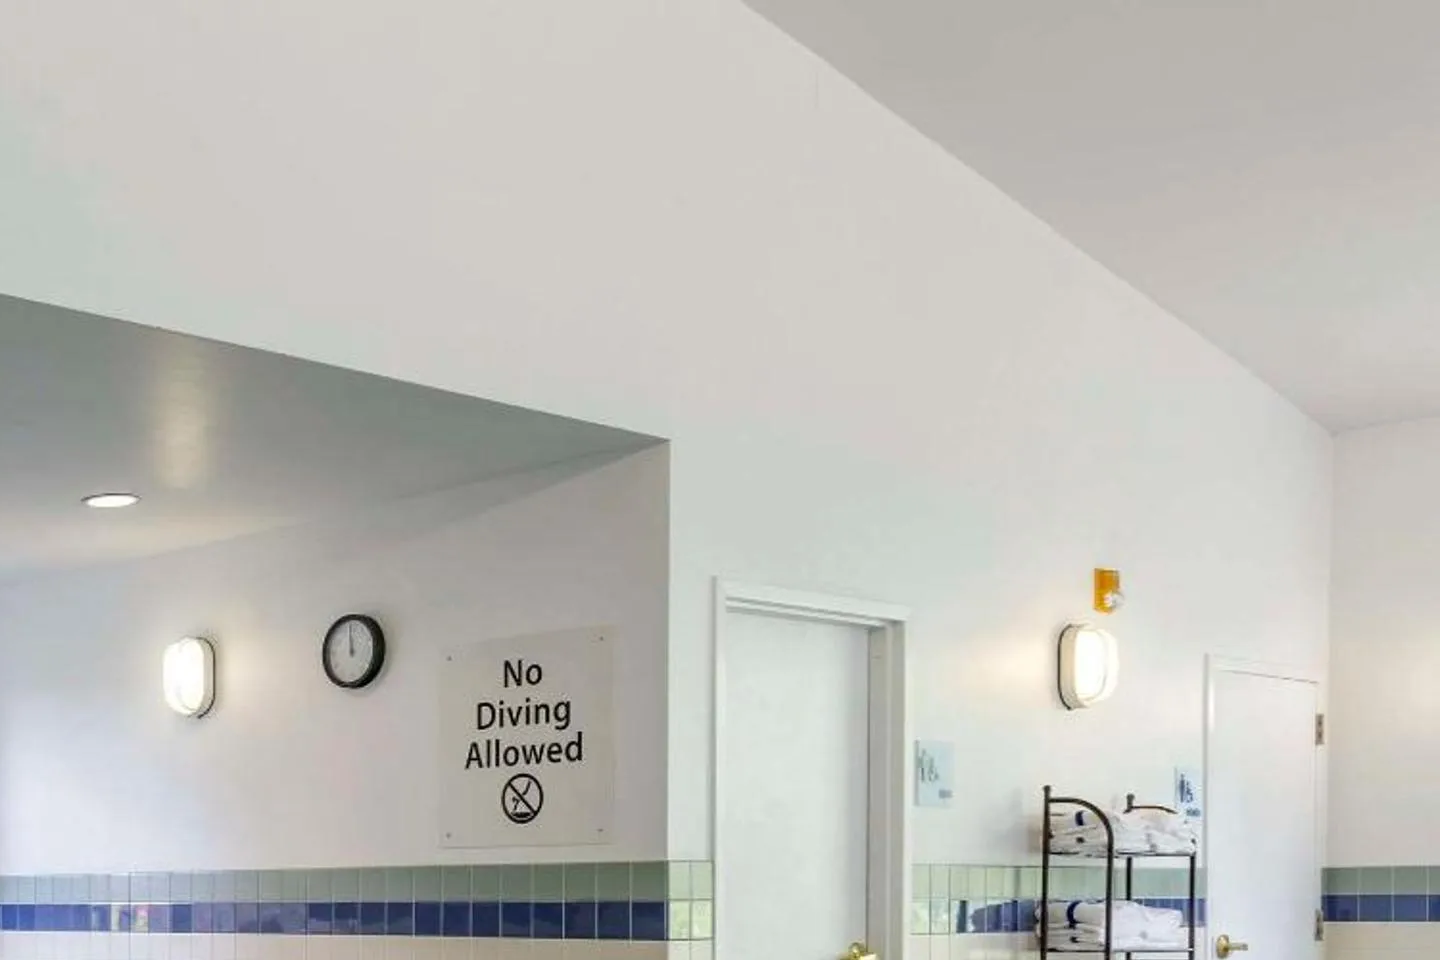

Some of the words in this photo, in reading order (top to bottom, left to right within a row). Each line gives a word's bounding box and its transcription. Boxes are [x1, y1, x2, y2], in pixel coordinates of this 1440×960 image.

[503, 659, 543, 688] No
[476, 697, 571, 730] Diving
[464, 731, 583, 770] Allowed
